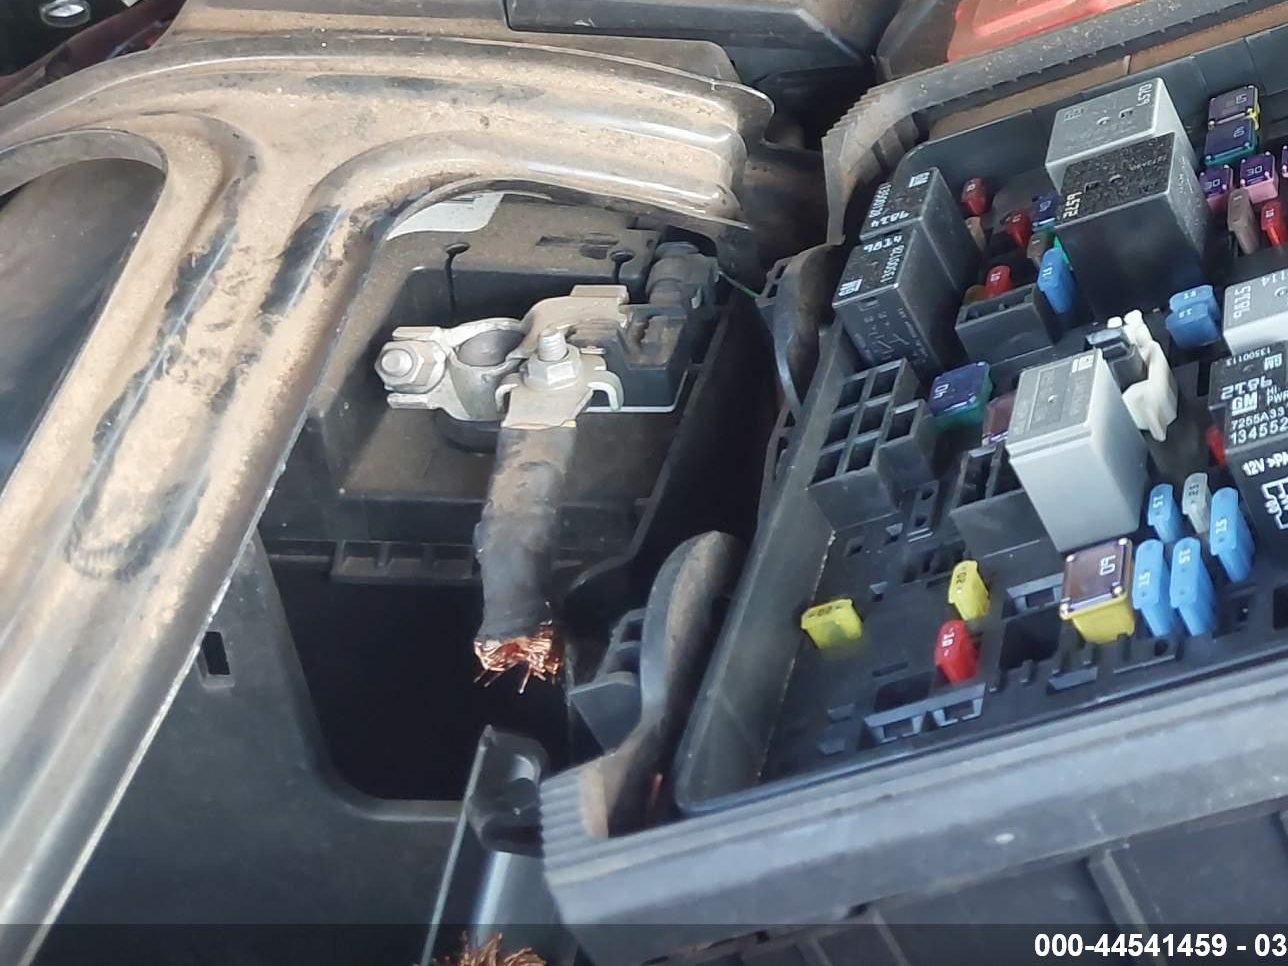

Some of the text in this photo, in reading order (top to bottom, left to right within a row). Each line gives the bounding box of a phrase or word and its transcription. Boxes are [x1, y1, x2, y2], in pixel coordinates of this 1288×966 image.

[1263, 353, 1282, 371] GM
[1232, 391, 1257, 416] GM
[1242, 457, 1265, 476] 12V
